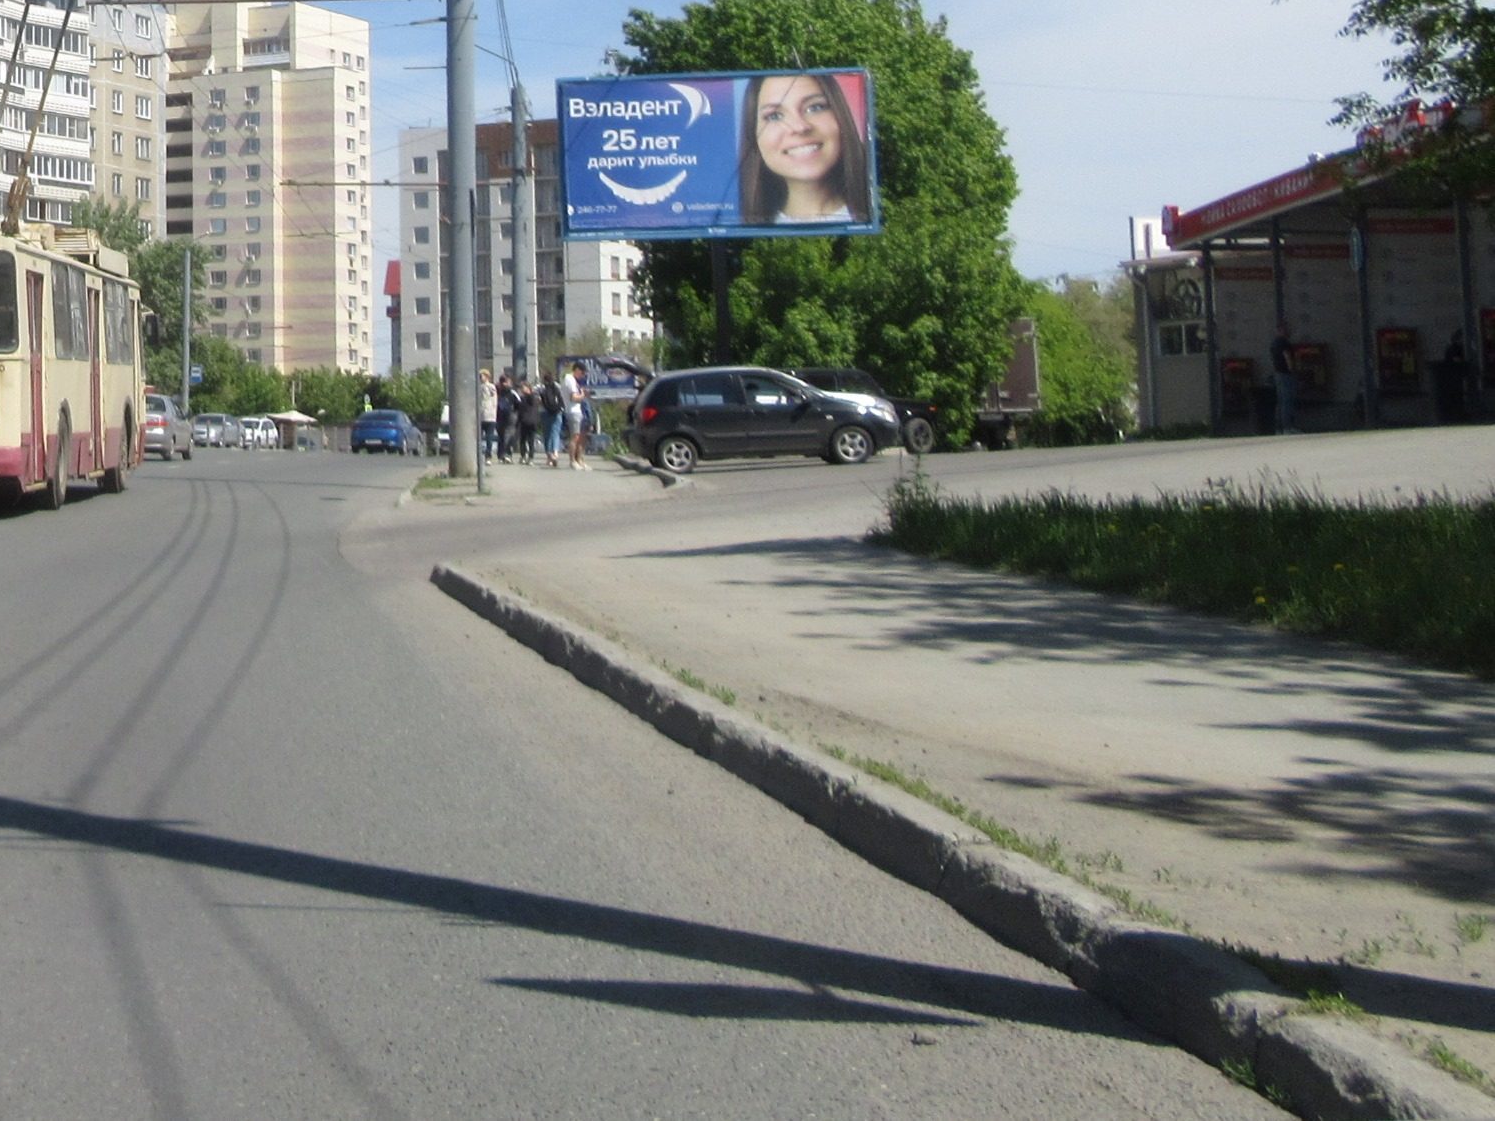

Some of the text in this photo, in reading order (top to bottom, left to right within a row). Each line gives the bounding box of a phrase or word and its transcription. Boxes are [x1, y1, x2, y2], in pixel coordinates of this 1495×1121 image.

[569, 97, 682, 120] Вэладент
[602, 129, 680, 151] 25 лет
[587, 153, 698, 170] дарит улыбки
